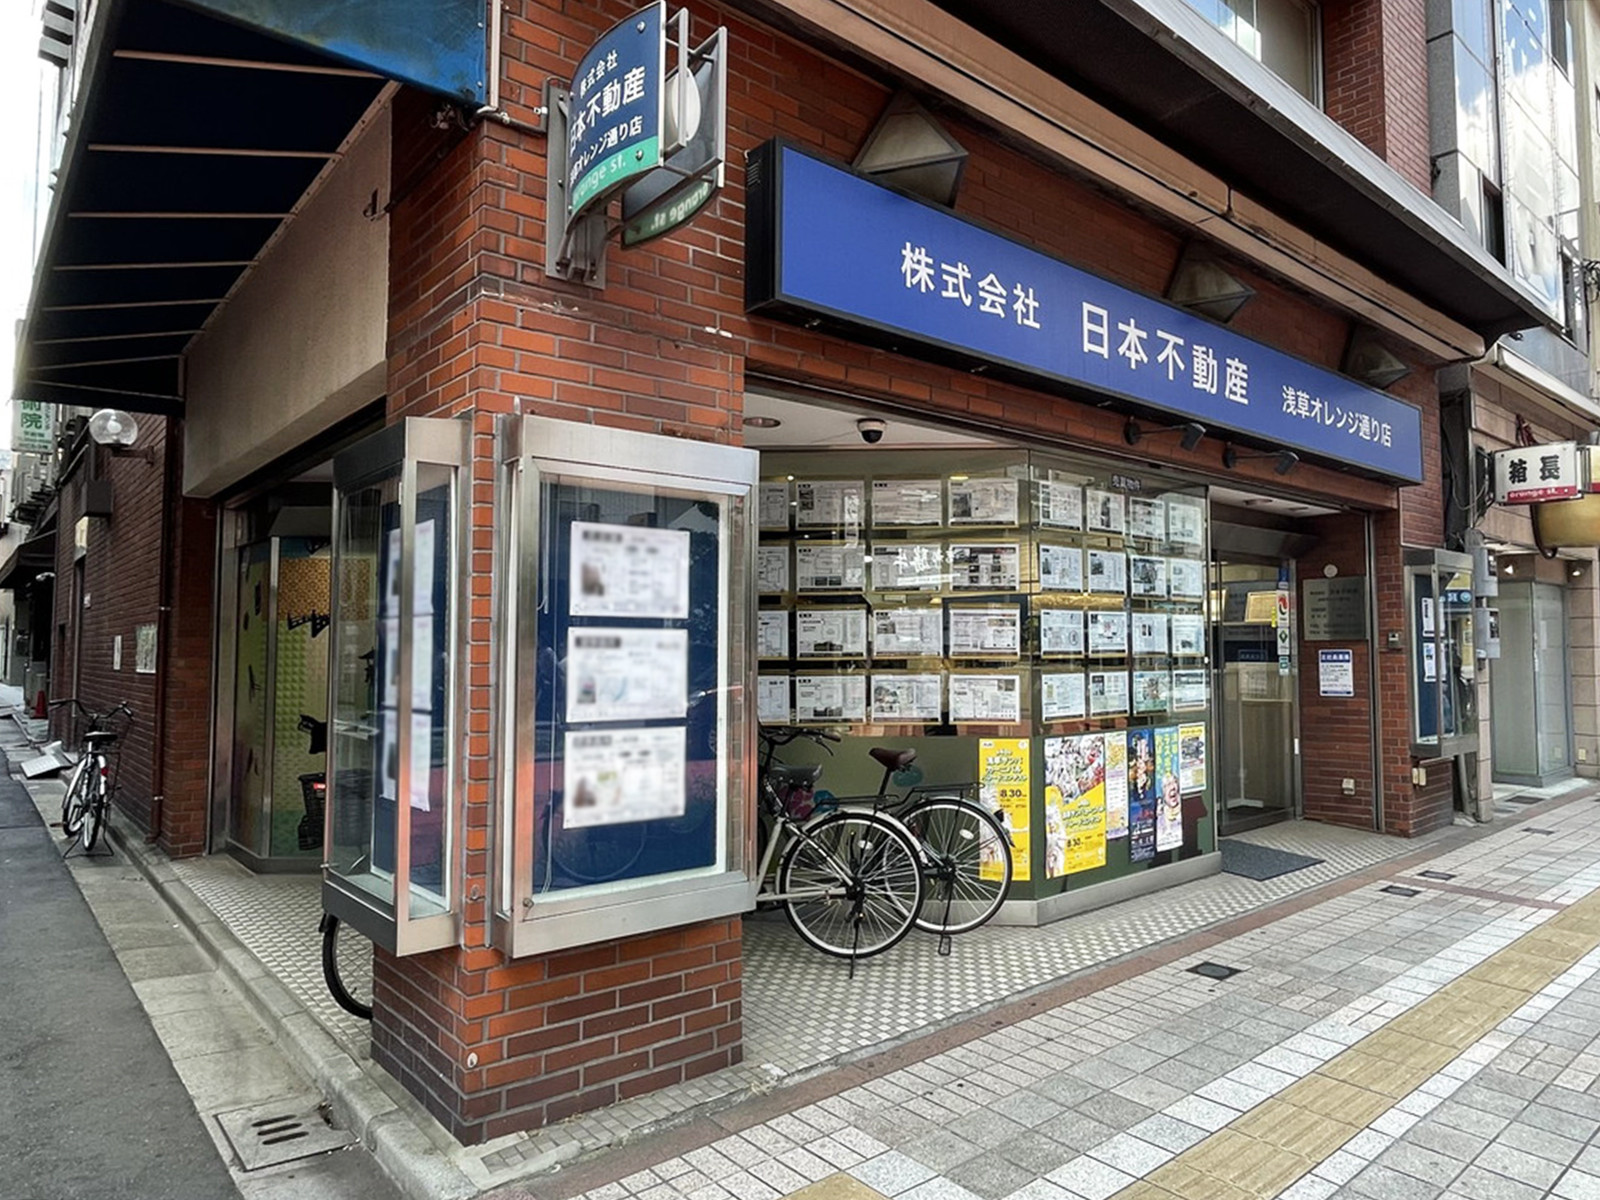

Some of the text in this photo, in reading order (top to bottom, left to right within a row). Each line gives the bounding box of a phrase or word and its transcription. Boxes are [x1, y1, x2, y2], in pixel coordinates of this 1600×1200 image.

[570, 66, 646, 158] 日本不動産
[900, 241, 1392, 449] 株式会社 日本不動産 浅草オレンジ通り店
[1508, 454, 1561, 485] 箱長
